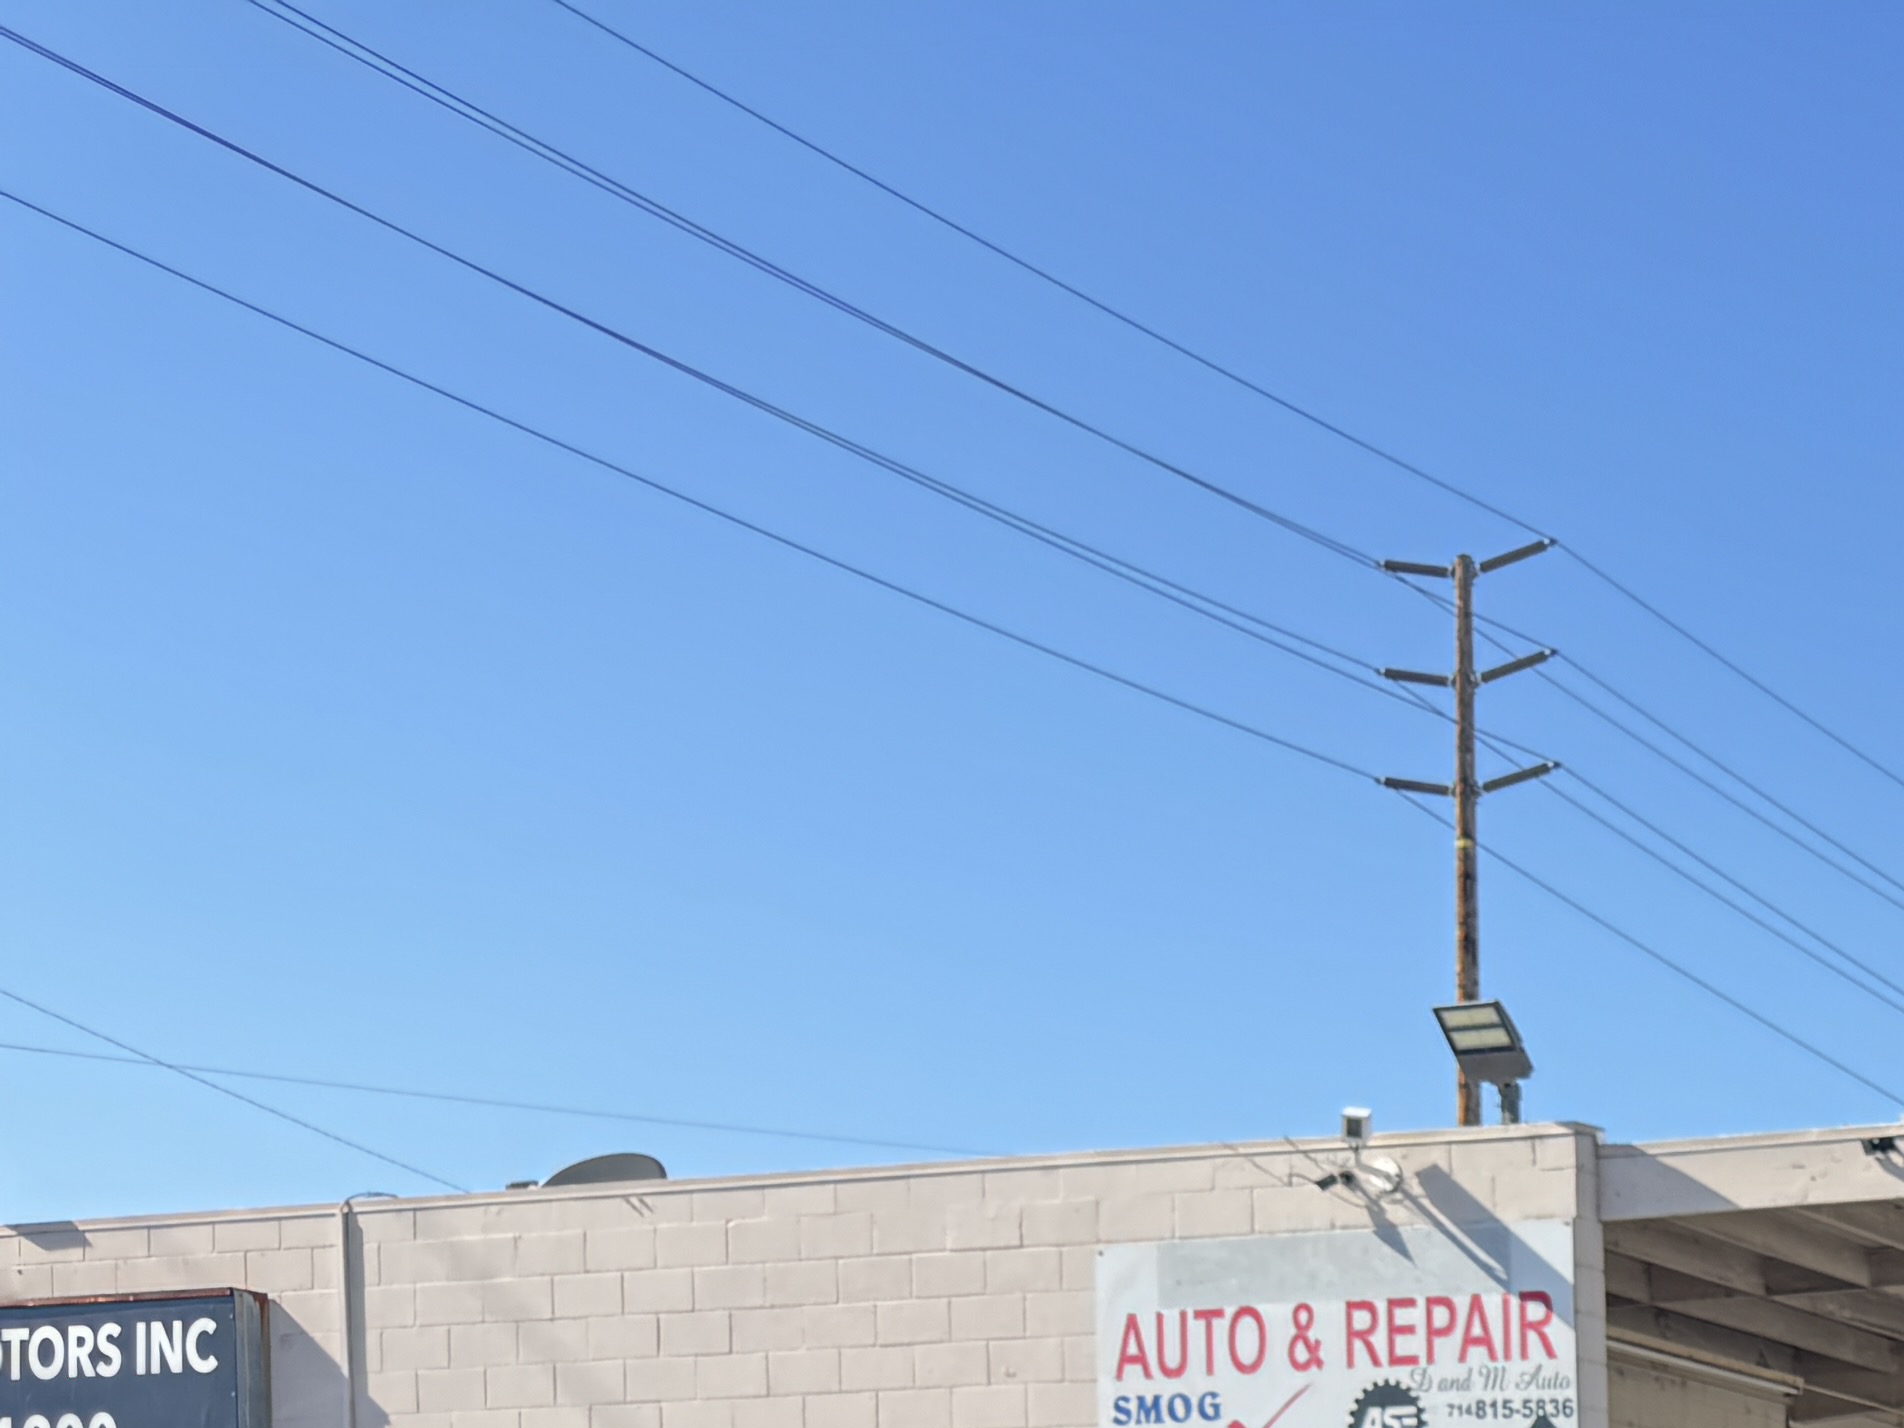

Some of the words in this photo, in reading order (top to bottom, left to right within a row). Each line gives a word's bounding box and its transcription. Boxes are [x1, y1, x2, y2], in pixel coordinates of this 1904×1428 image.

[0, 1323, 122, 1381] TORS
[135, 1317, 218, 1377] INC
[1115, 1305, 1267, 1381] AUTO
[1287, 1302, 1324, 1373] &
[1344, 1290, 1558, 1371] REPAIR
[1437, 1367, 1473, 1393] and
[1515, 1363, 1572, 1392] Auto
[1112, 1390, 1223, 1427] SMOG
